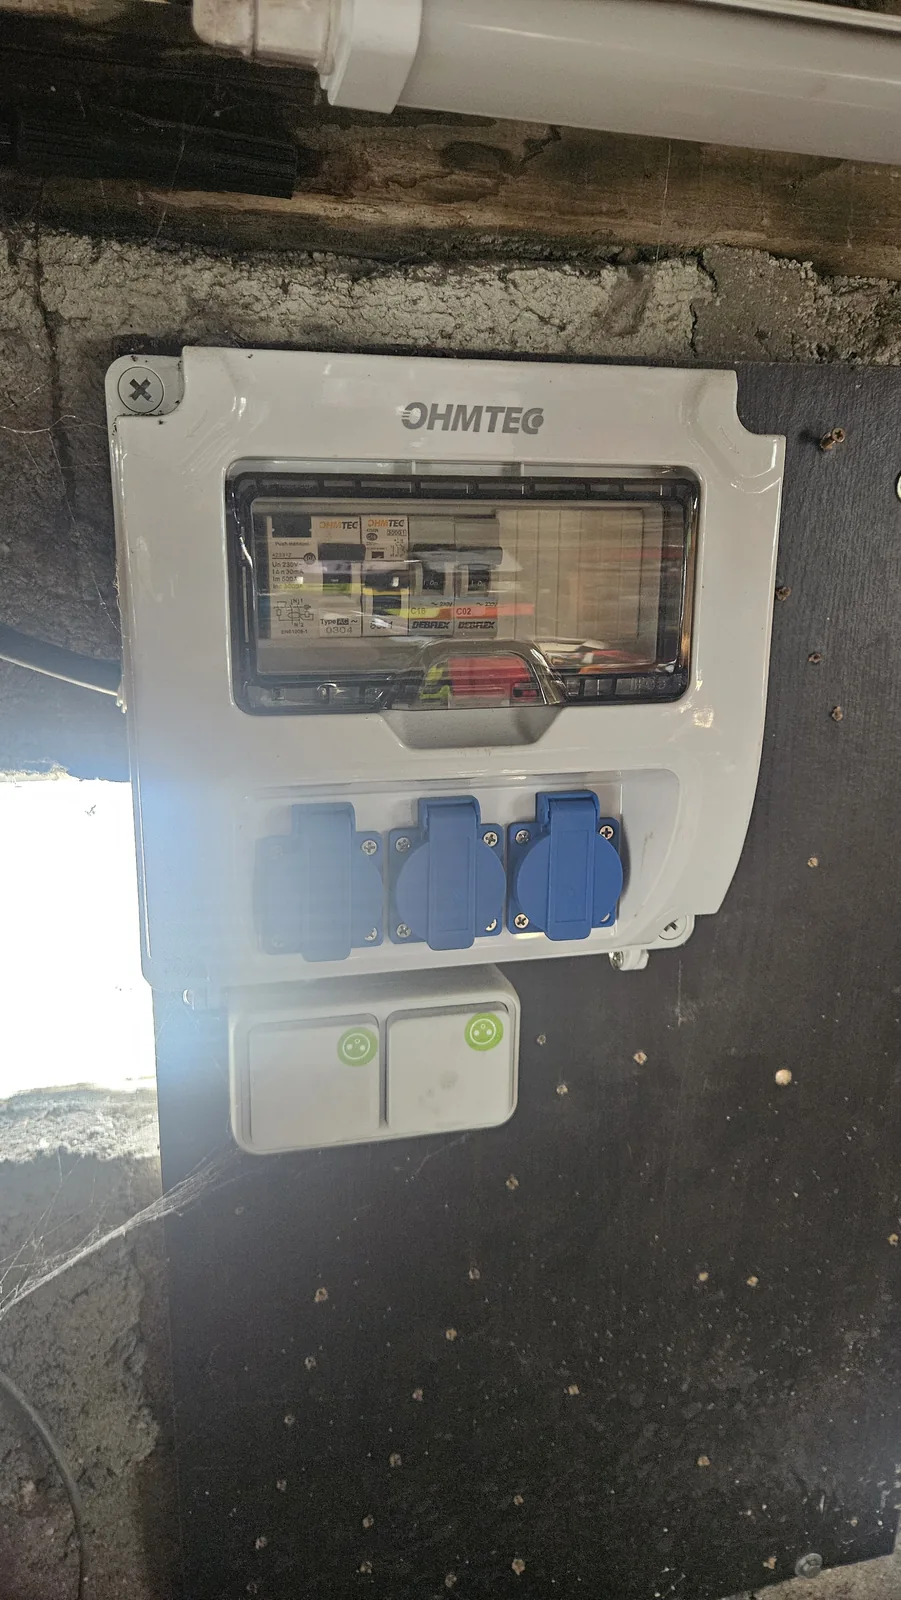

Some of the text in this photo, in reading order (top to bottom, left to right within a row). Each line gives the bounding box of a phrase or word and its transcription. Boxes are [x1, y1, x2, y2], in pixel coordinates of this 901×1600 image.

[401, 401, 545, 435] OHMTEC
[319, 520, 359, 529] OHMTEC
[367, 519, 405, 527] OHMTEC
[412, 621, 450, 629] DEBFLEX
